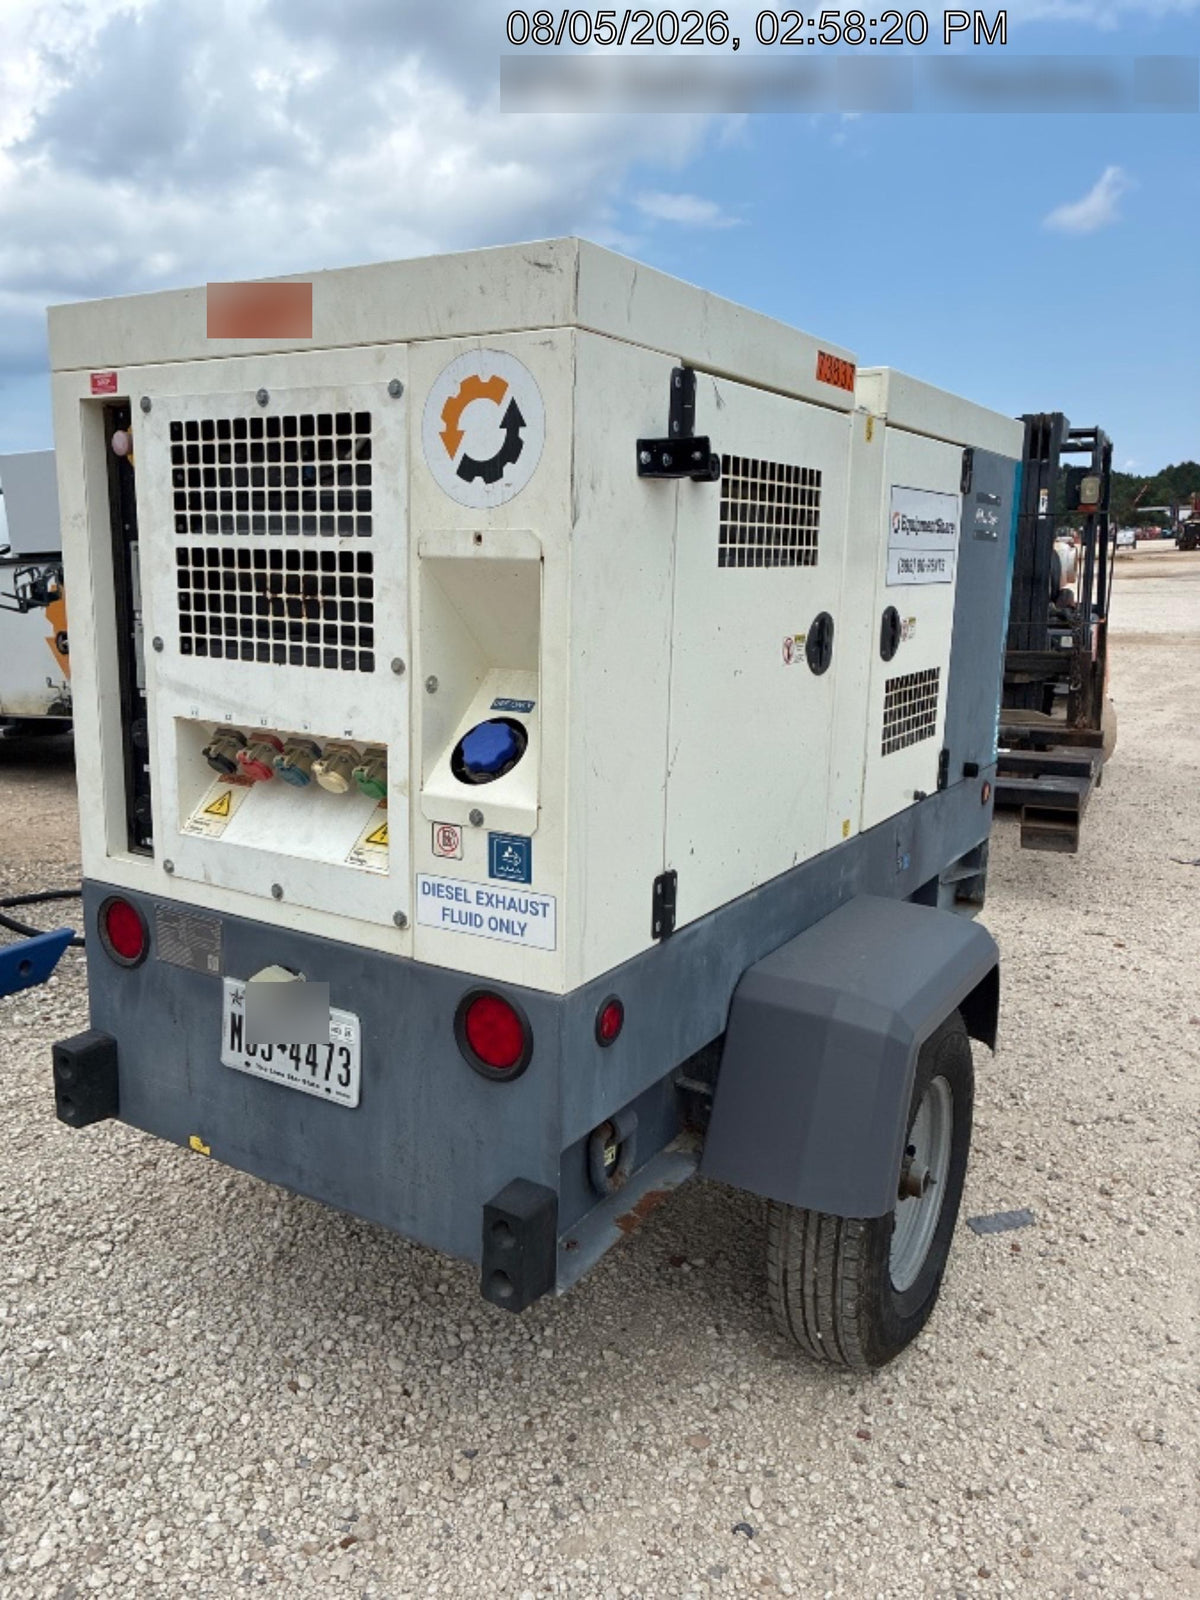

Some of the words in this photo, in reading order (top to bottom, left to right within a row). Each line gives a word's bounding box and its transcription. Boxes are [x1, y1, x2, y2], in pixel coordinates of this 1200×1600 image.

[422, 881, 471, 905] DIESEL
[475, 890, 550, 918] EXHAUST
[442, 907, 484, 929] FLUID
[488, 915, 528, 937] ONLY
